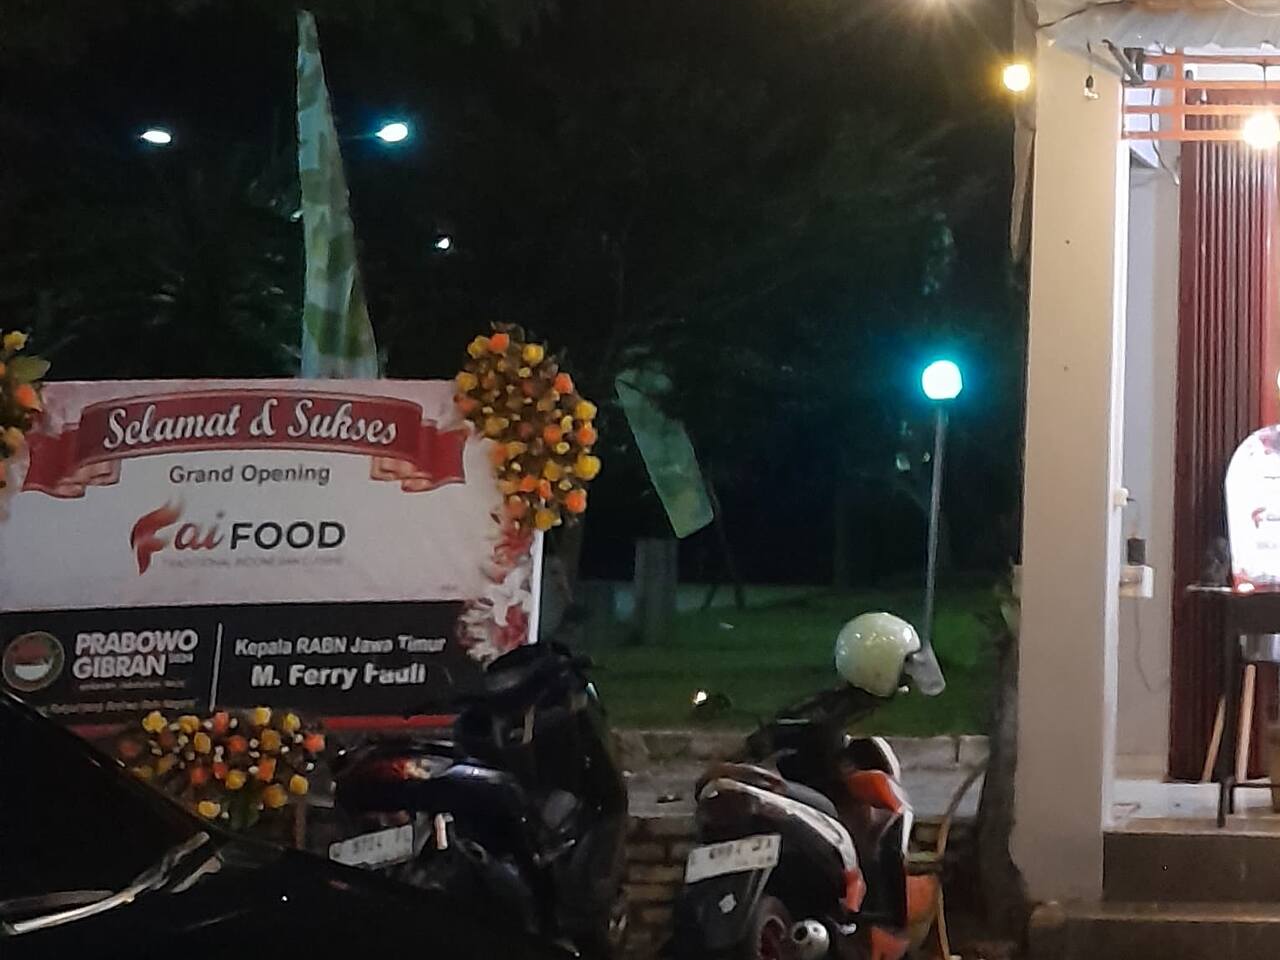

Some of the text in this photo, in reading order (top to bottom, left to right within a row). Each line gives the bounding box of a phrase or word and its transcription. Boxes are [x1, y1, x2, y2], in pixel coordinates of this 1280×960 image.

[103, 404, 241, 449] Selamat
[287, 399, 397, 445] Sukses
[169, 463, 331, 486] Grand Opening
[229, 521, 346, 550] FOOD
[74, 628, 199, 656] PRABOWO
[234, 638, 293, 658] Kepala
[350, 636, 394, 653] Jawa
[72, 653, 167, 679] GIBRAN
[251, 664, 281, 687] M.
[288, 664, 357, 690] Ferry
